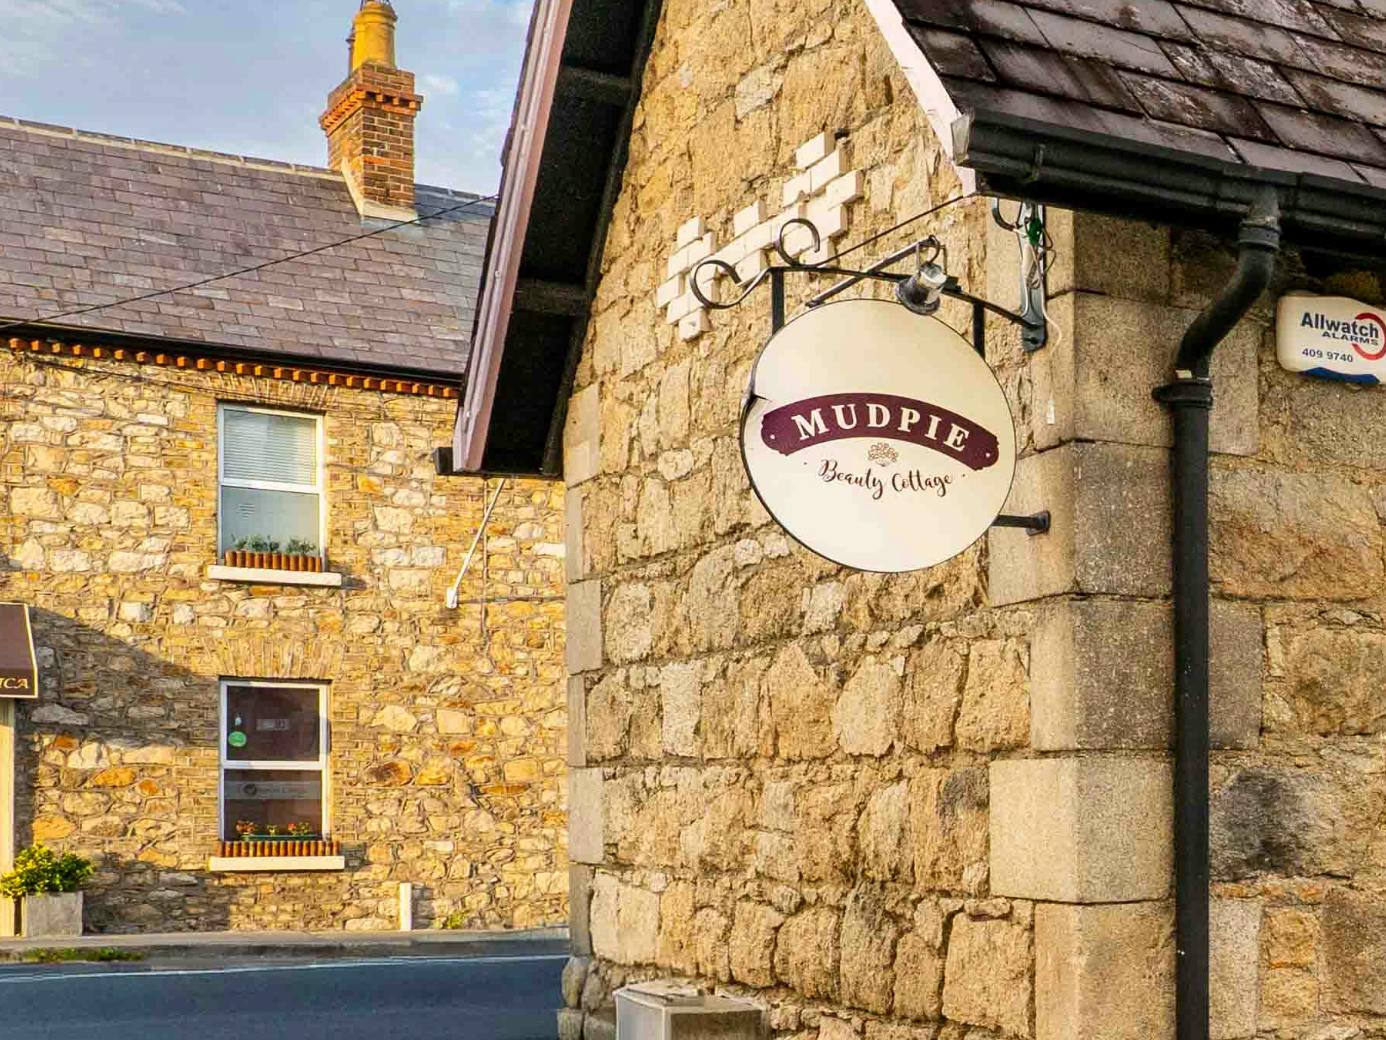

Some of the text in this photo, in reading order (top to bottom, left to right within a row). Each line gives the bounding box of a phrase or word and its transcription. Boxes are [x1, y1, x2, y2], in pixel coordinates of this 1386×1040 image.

[1300, 311, 1379, 339] Allwatch
[1321, 331, 1379, 346] ALARMS
[1302, 348, 1354, 364] 409 9740
[791, 403, 970, 452] MUDPIE
[818, 459, 954, 500] Beauty Cottage
